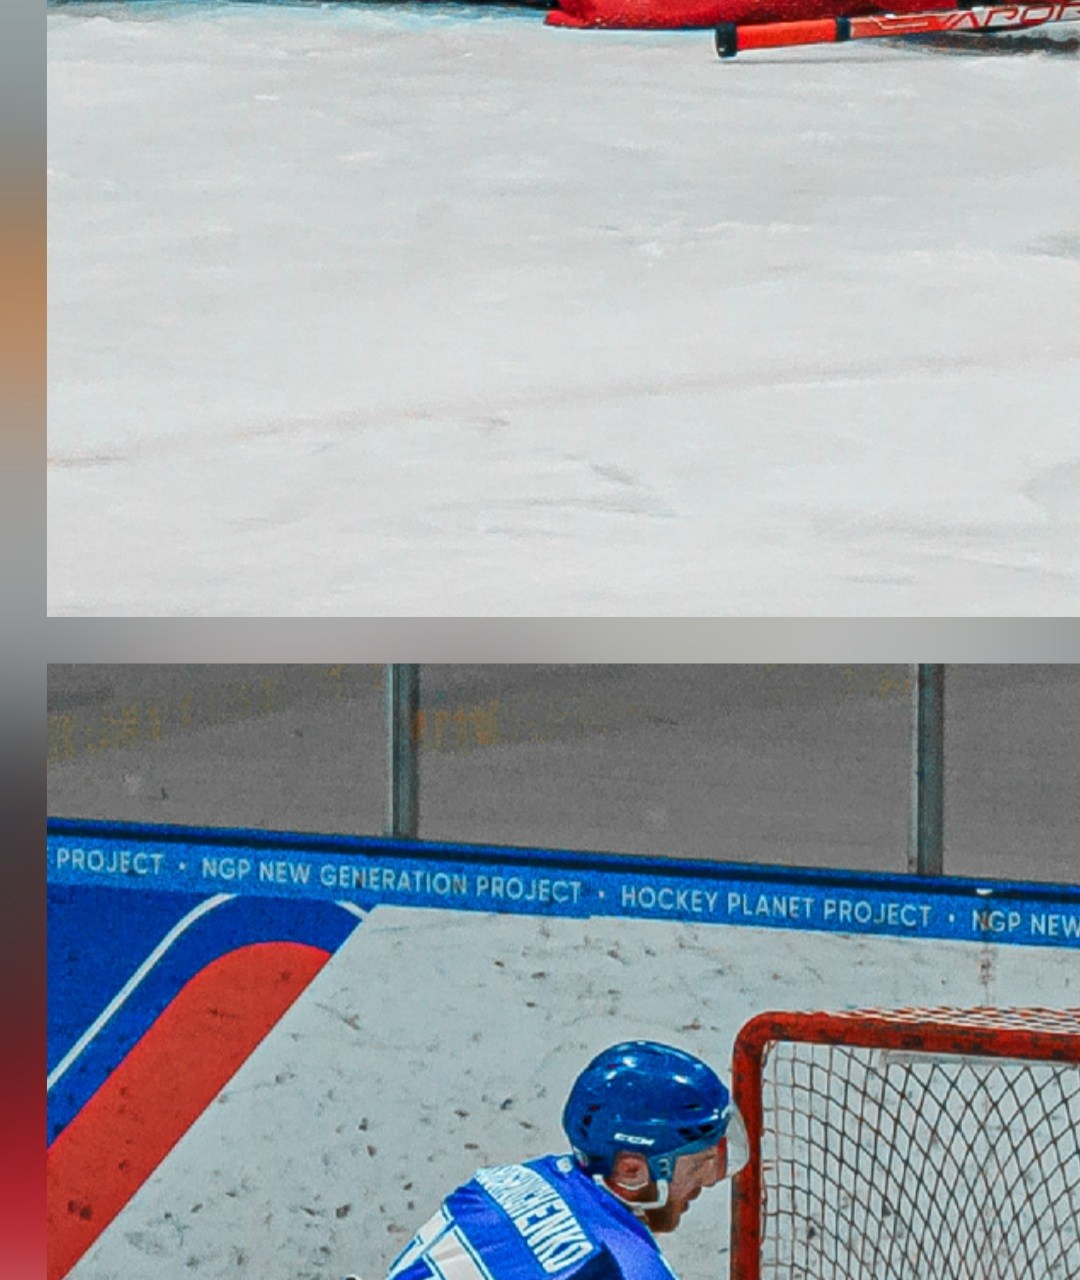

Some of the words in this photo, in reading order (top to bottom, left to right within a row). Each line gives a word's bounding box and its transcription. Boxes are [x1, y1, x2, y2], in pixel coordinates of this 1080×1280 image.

[57, 847, 163, 875] PROJECT
[201, 857, 250, 881] NGP
[259, 861, 311, 885] NEW
[320, 865, 468, 895] GENERATION
[476, 875, 582, 903] PROJECT
[621, 885, 718, 913] HOCKEY
[727, 892, 814, 919] PLANET
[823, 899, 932, 927] PROJECT
[972, 909, 1021, 933] NGP
